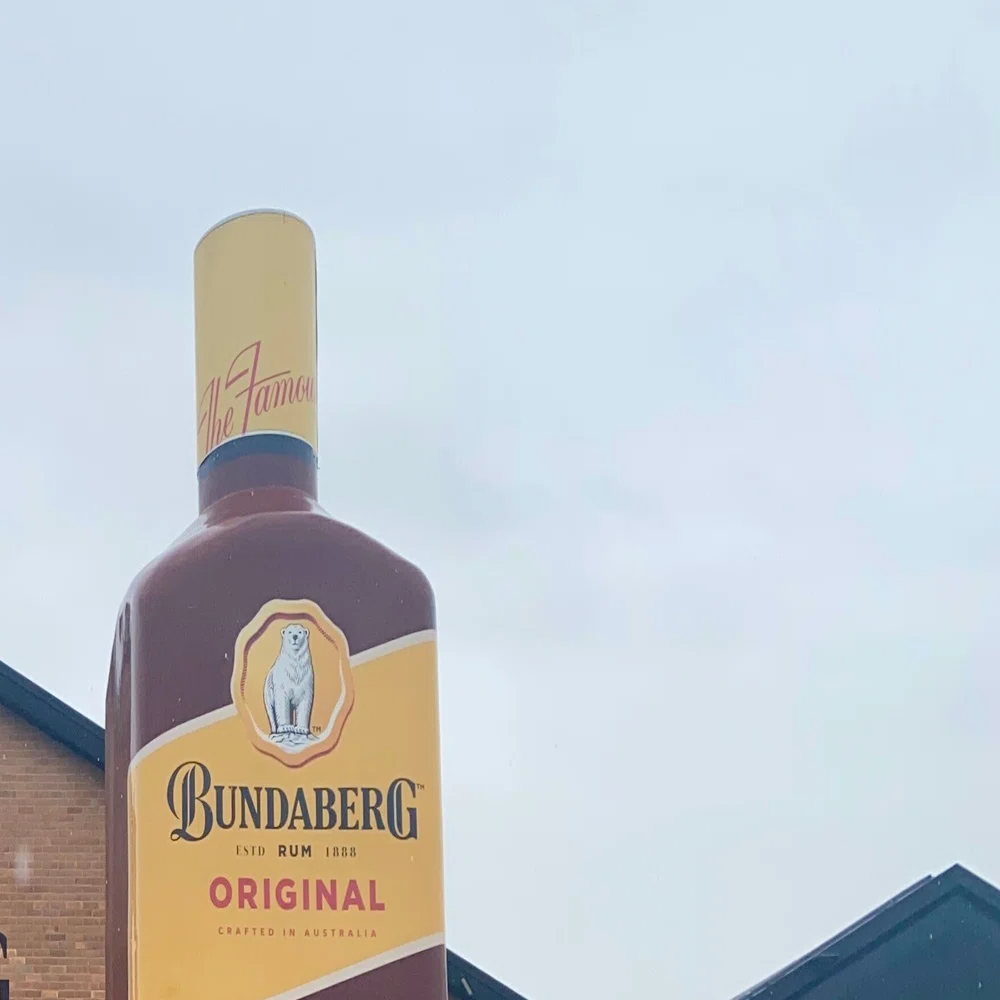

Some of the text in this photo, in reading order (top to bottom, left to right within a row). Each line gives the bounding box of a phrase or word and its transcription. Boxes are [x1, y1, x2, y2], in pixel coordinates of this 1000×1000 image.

[197, 340, 315, 454] The Famou
[166, 760, 418, 842] BUNDABERG
[236, 845, 357, 858] ESTD RUM 1888
[209, 876, 386, 912] ORIGINAL
[218, 926, 378, 938] CRAFTED IN AUSTRALIA
